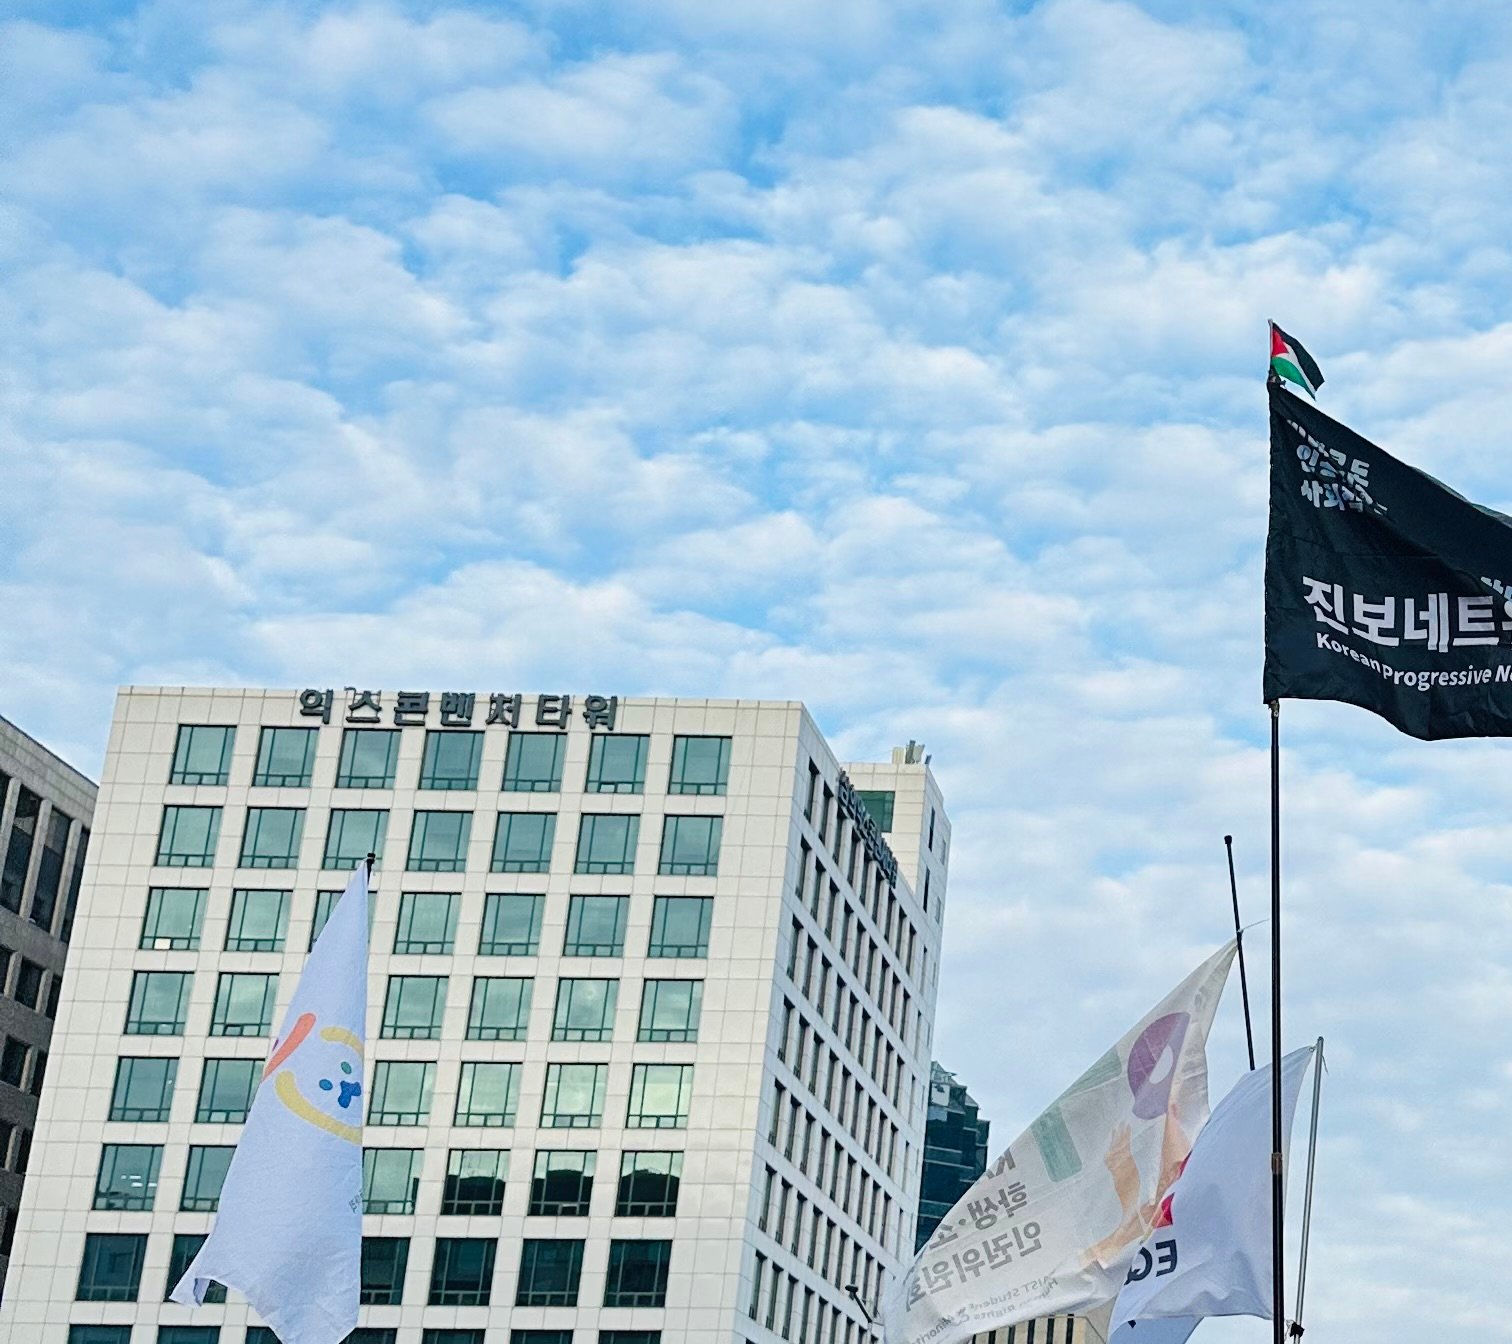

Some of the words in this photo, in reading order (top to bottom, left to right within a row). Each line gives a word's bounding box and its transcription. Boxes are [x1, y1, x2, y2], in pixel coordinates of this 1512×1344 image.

[1316, 632, 1382, 674] Korean
[1383, 664, 1492, 692] Progressive
[299, 687, 618, 731] 익스콘벤처타워
